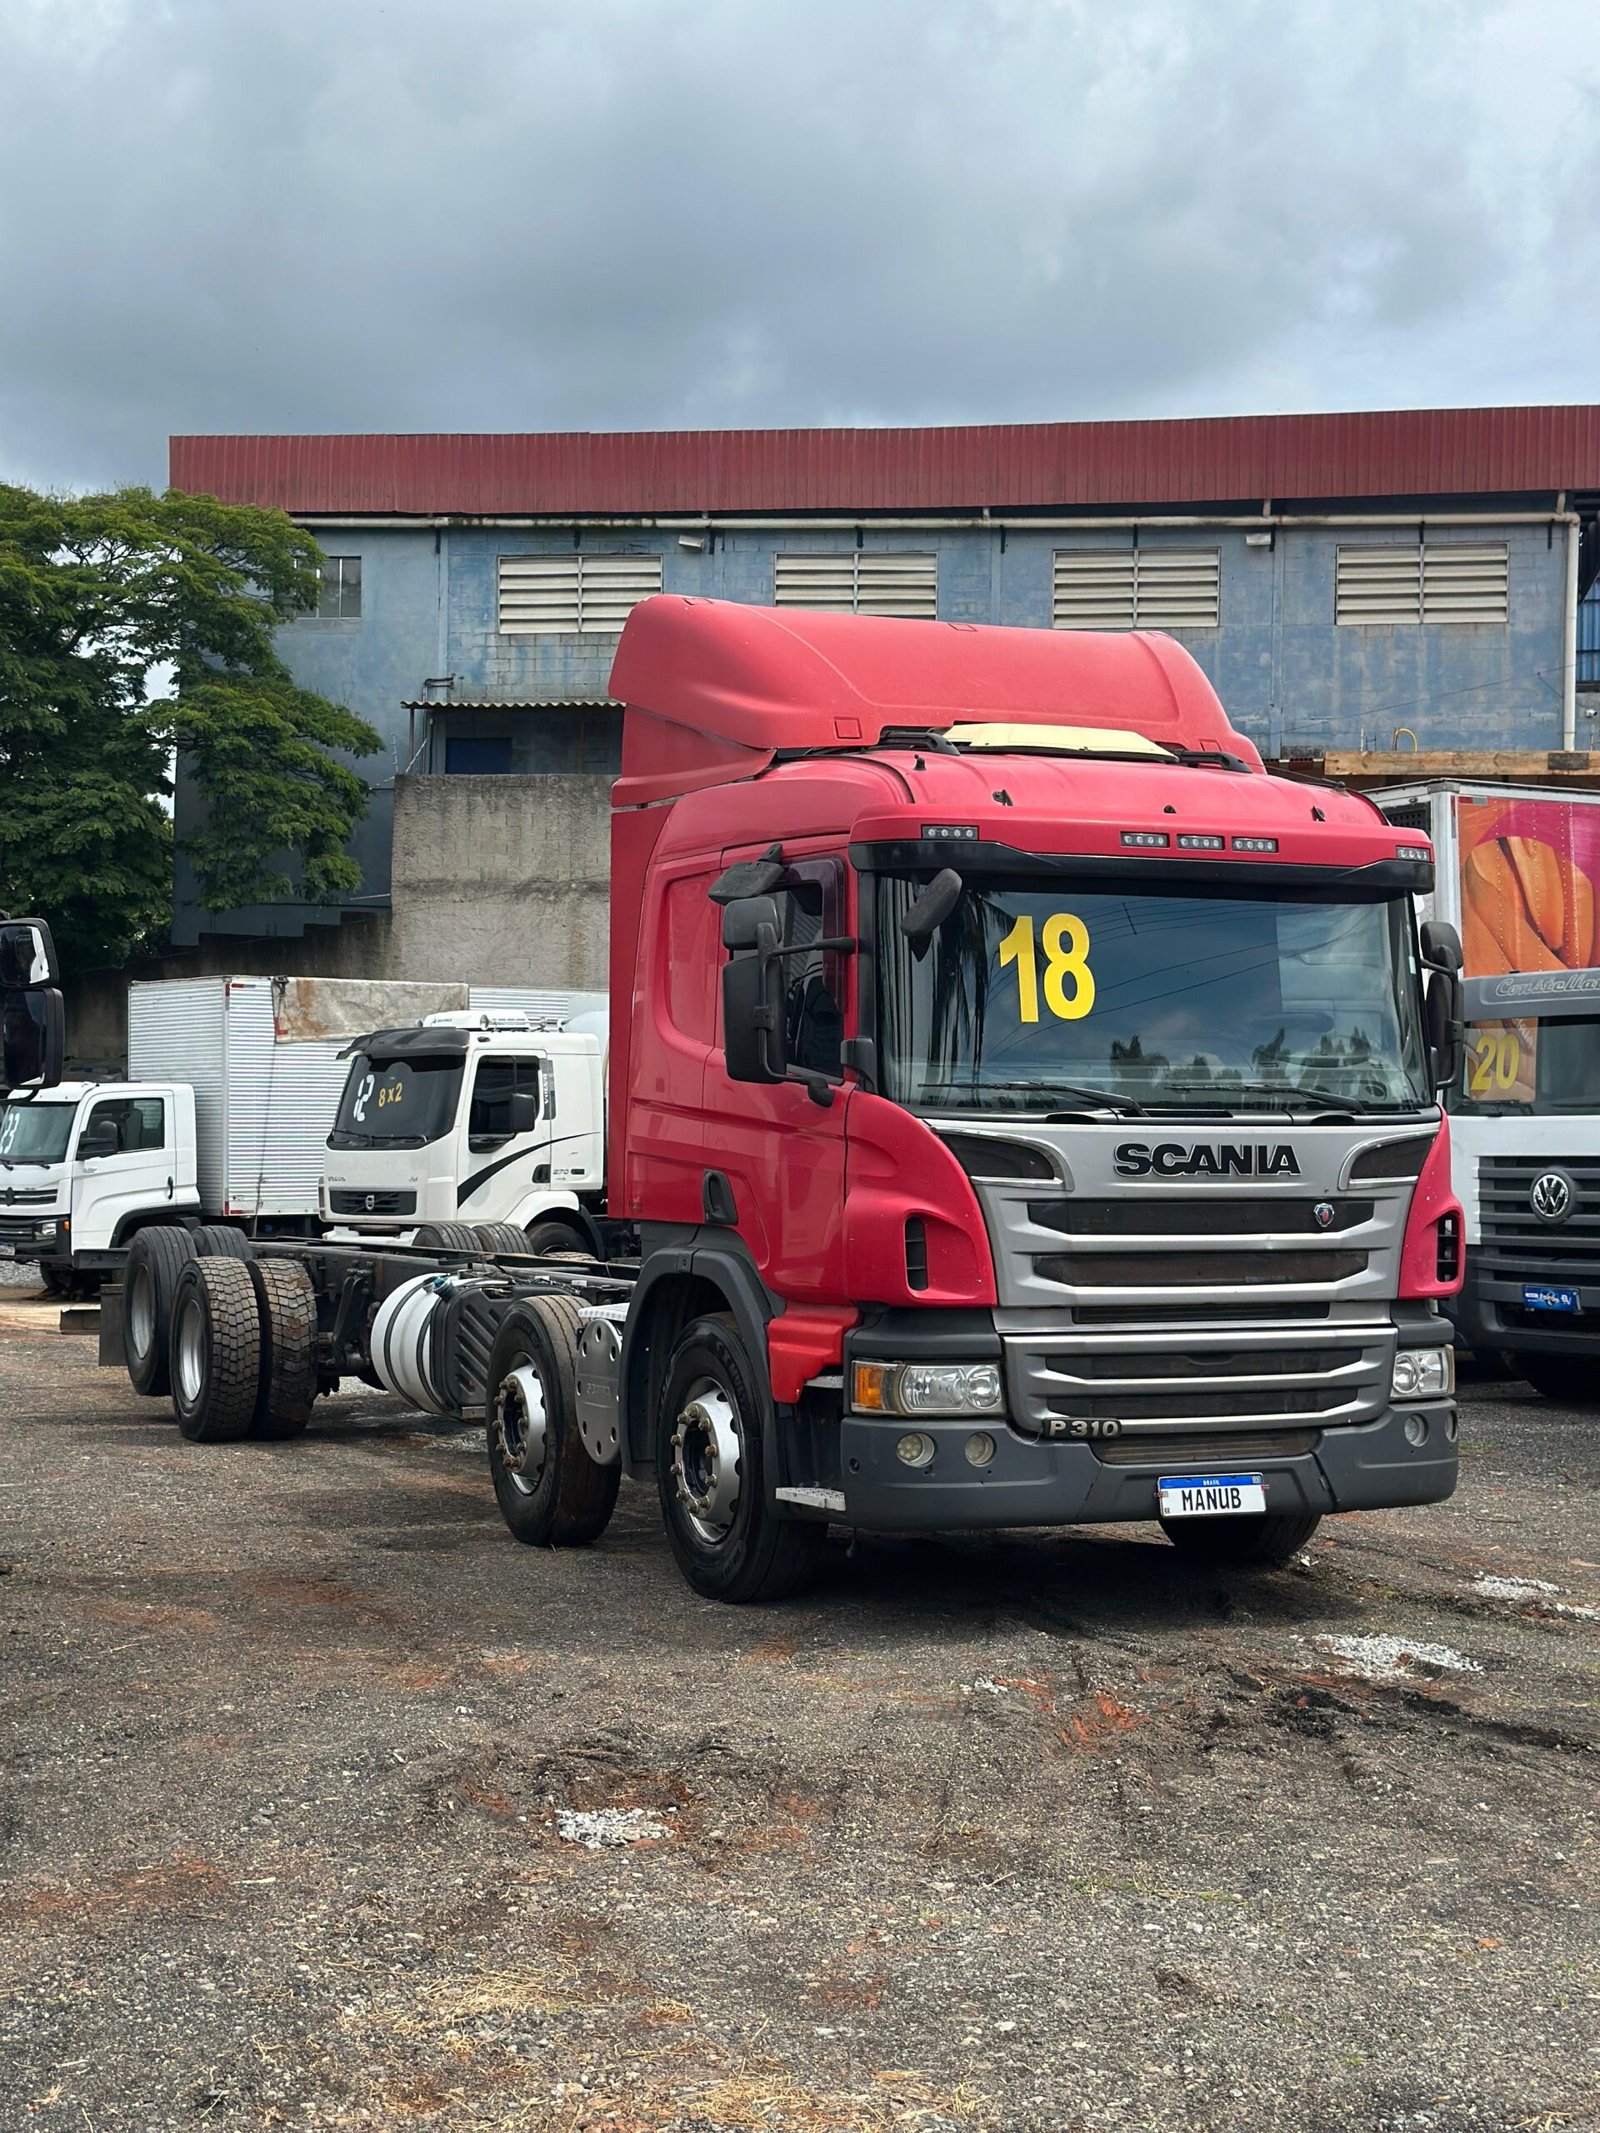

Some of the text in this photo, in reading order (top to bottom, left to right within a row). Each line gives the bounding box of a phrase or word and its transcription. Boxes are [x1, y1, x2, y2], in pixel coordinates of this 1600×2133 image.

[999, 912, 1096, 1023] 18
[1470, 1033, 1519, 1090] 20
[353, 1074, 375, 1122] 12
[1114, 1142, 1302, 1177] SCANIA
[1181, 1487, 1242, 1511] MANUB
